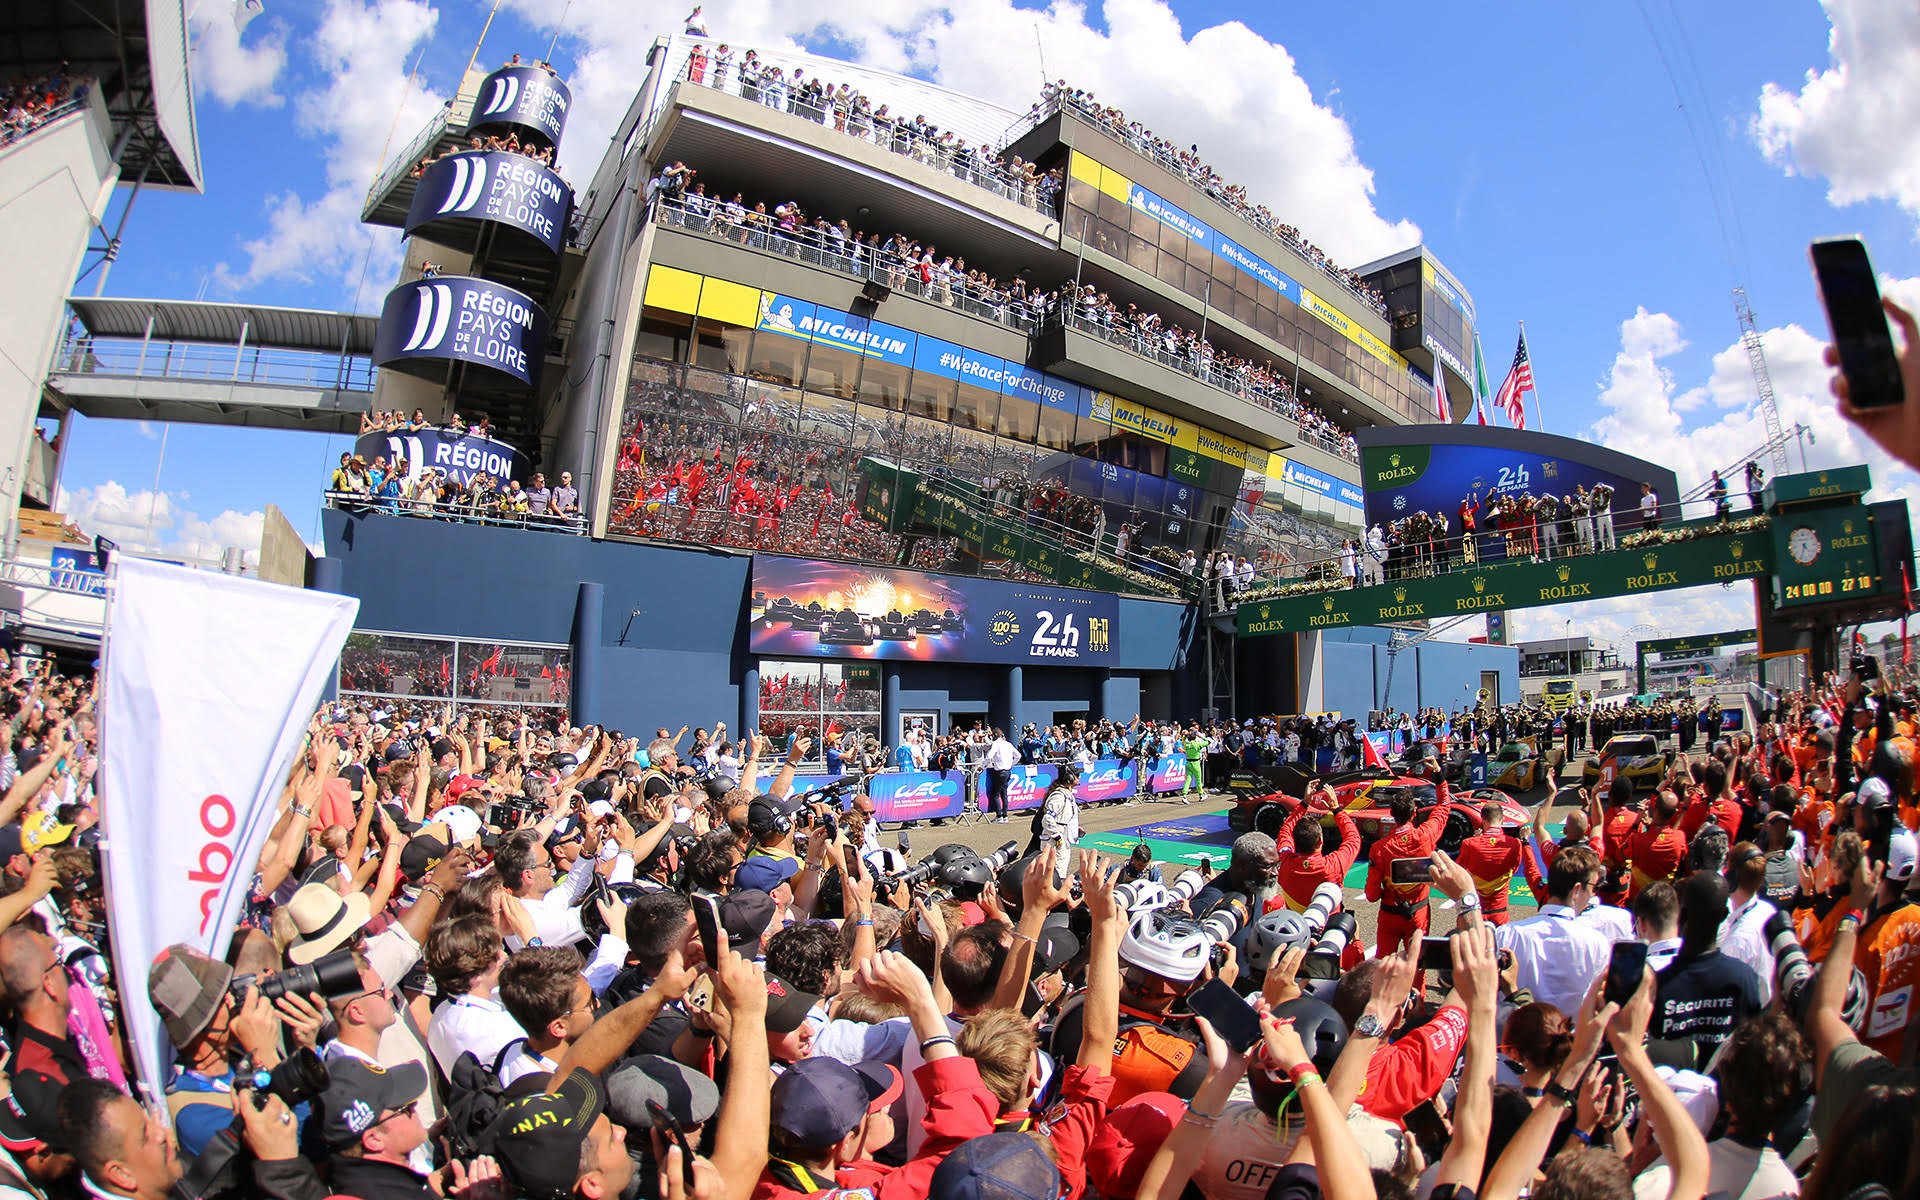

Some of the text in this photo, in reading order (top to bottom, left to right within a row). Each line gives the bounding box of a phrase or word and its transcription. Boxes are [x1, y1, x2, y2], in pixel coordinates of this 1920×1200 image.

[519, 101, 529, 109] DE
[521, 91, 555, 114] PAYS
[525, 78, 567, 113] RÉGION
[518, 107, 562, 137] LA LOIRE
[497, 160, 562, 204] RÉGION
[489, 196, 503, 207] DE
[491, 178, 541, 209] PAYS
[486, 203, 554, 240] LA LOIRE
[1147, 200, 1205, 240] MICHELIN
[462, 288, 534, 331] RÉGION
[1313, 302, 1348, 331] MICHELIN
[457, 310, 513, 342] PAYS
[798, 314, 907, 356] MICHELIN
[456, 332, 471, 343] DE
[453, 343, 528, 373] LA LOIRE
[939, 351, 1066, 402] #WeRaceForChange
[1114, 407, 1179, 438] MICHELIN
[435, 441, 512, 480] RÉGION
[1197, 435, 1268, 469] #WeRaceForChange
[1294, 470, 1331, 492] MICHELIN
[1377, 465, 1416, 481] ROLEX
[1498, 463, 1530, 487] 24h
[1808, 484, 1841, 496] ROLEX
[1831, 535, 1869, 549] ROLEX
[1713, 559, 1765, 578] ROLEX
[1627, 571, 1679, 589] ROLEX
[1785, 585, 1800, 599] 24
[1841, 578, 1856, 592] 27
[1456, 593, 1505, 610] ROLEX
[1539, 582, 1591, 601] ROLEX
[1309, 612, 1350, 626] ROLEX
[1379, 603, 1425, 619] ROLEX
[992, 621, 1010, 633] 100
[1031, 610, 1080, 647] 24h
[1088, 617, 1108, 631] 10-11
[1248, 619, 1284, 633] ROLEX
[1088, 630, 1108, 645] JUIN
[1088, 644, 1109, 652] 2023
[1029, 645, 1045, 656] LE
[894, 782, 943, 798] WEC
[1007, 773, 1037, 795] 24h
[1664, 996, 1734, 1016] SÉCURITÉ
[1662, 1015, 1733, 1033] PROTECTION
[342, 1098, 371, 1129] 24h
[1226, 1159, 1279, 1187] OFF
